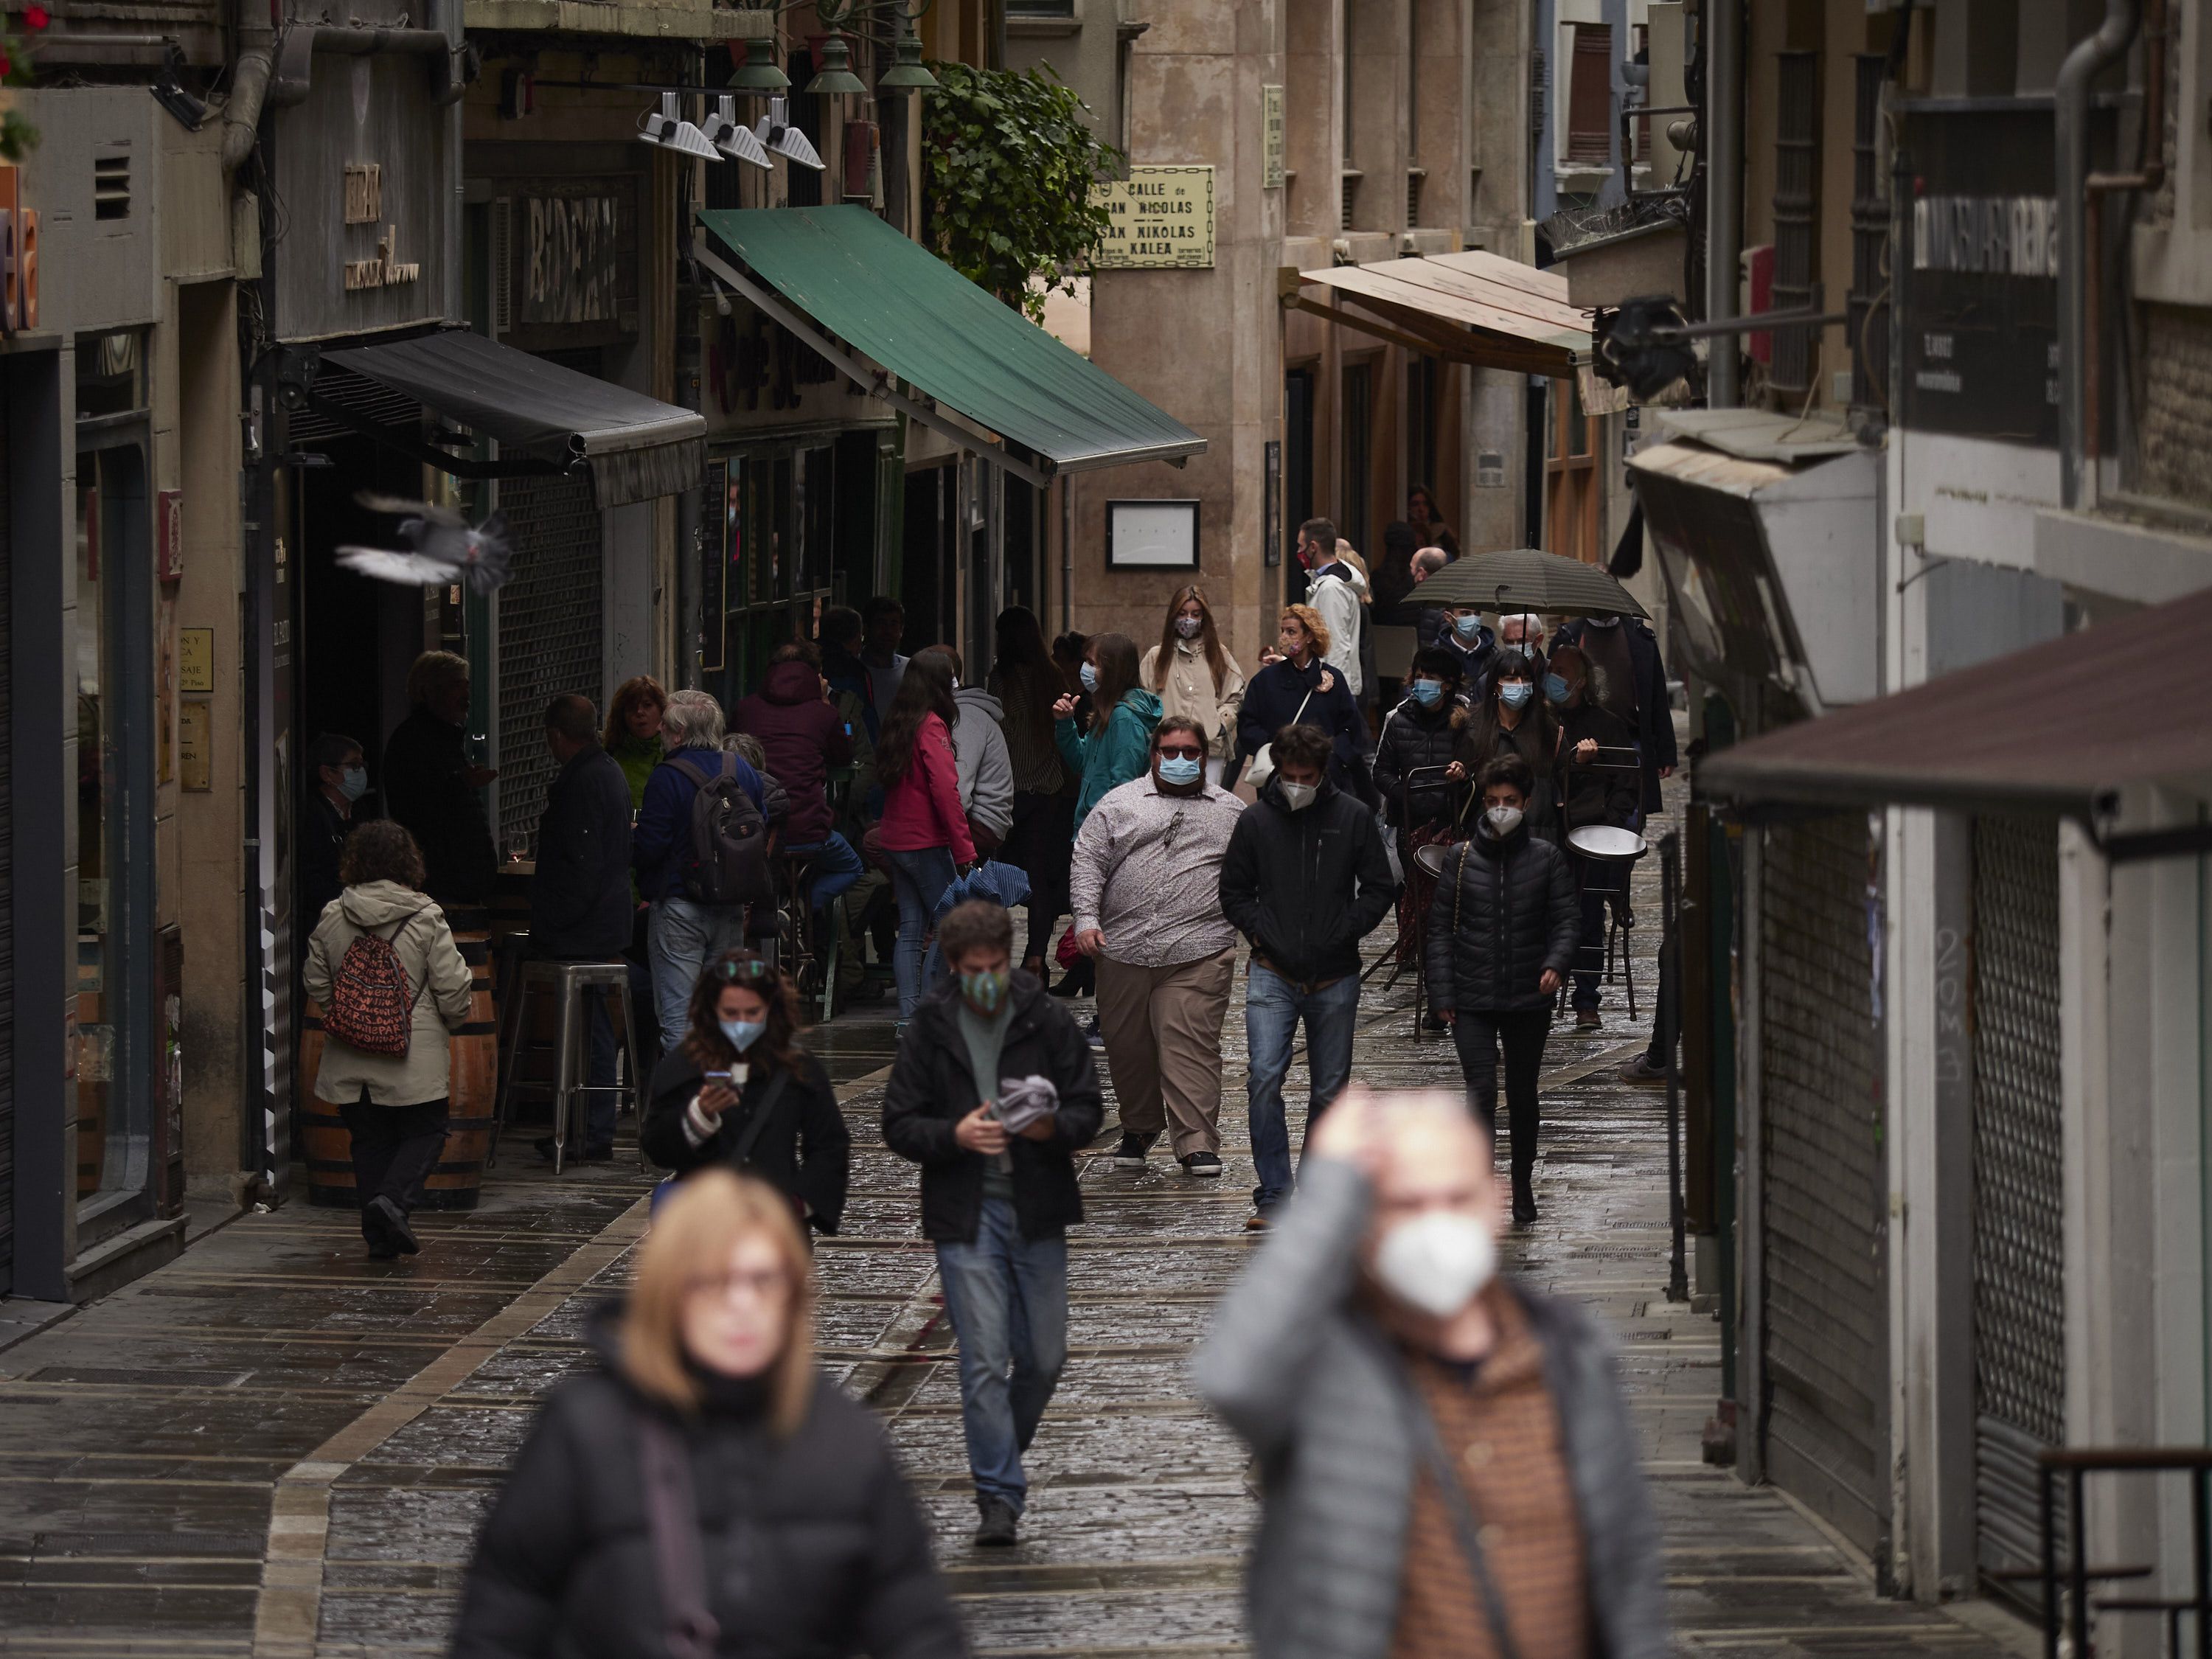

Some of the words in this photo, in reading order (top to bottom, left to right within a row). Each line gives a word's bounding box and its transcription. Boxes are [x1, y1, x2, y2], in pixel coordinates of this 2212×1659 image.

[1129, 184, 1166, 195] CALLE
[1175, 187, 1185, 195] de
[1103, 202, 1126, 214] SAN
[1139, 201, 1192, 214] NICOLAS
[1101, 226, 1126, 238] SAN
[1138, 226, 1194, 238] NIKOLAS
[1130, 243, 1172, 254] KALEA
